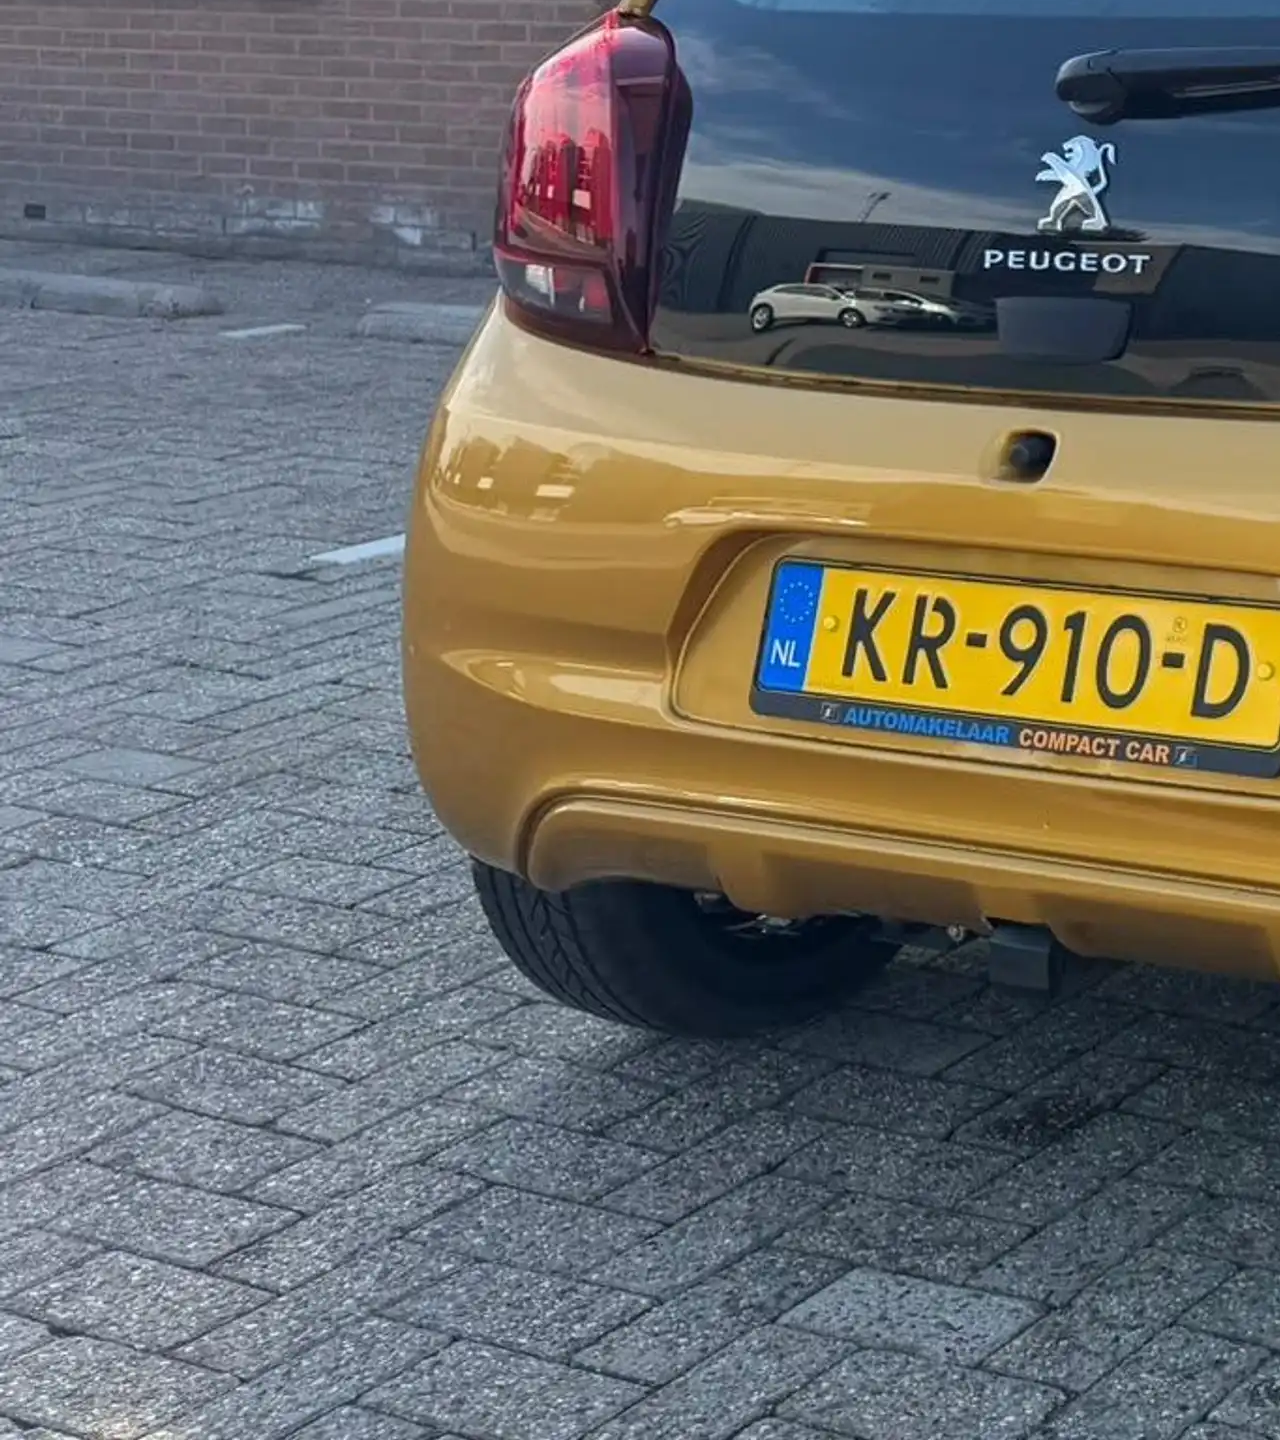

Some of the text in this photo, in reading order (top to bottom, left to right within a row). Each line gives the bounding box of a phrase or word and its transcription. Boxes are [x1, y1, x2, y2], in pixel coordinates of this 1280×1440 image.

[984, 249, 1151, 275] PEUGEOT
[771, 587, 1251, 720] NL KR-910-D
[843, 706, 1171, 764] AUTOMAKELAAR COMPACT CAR
